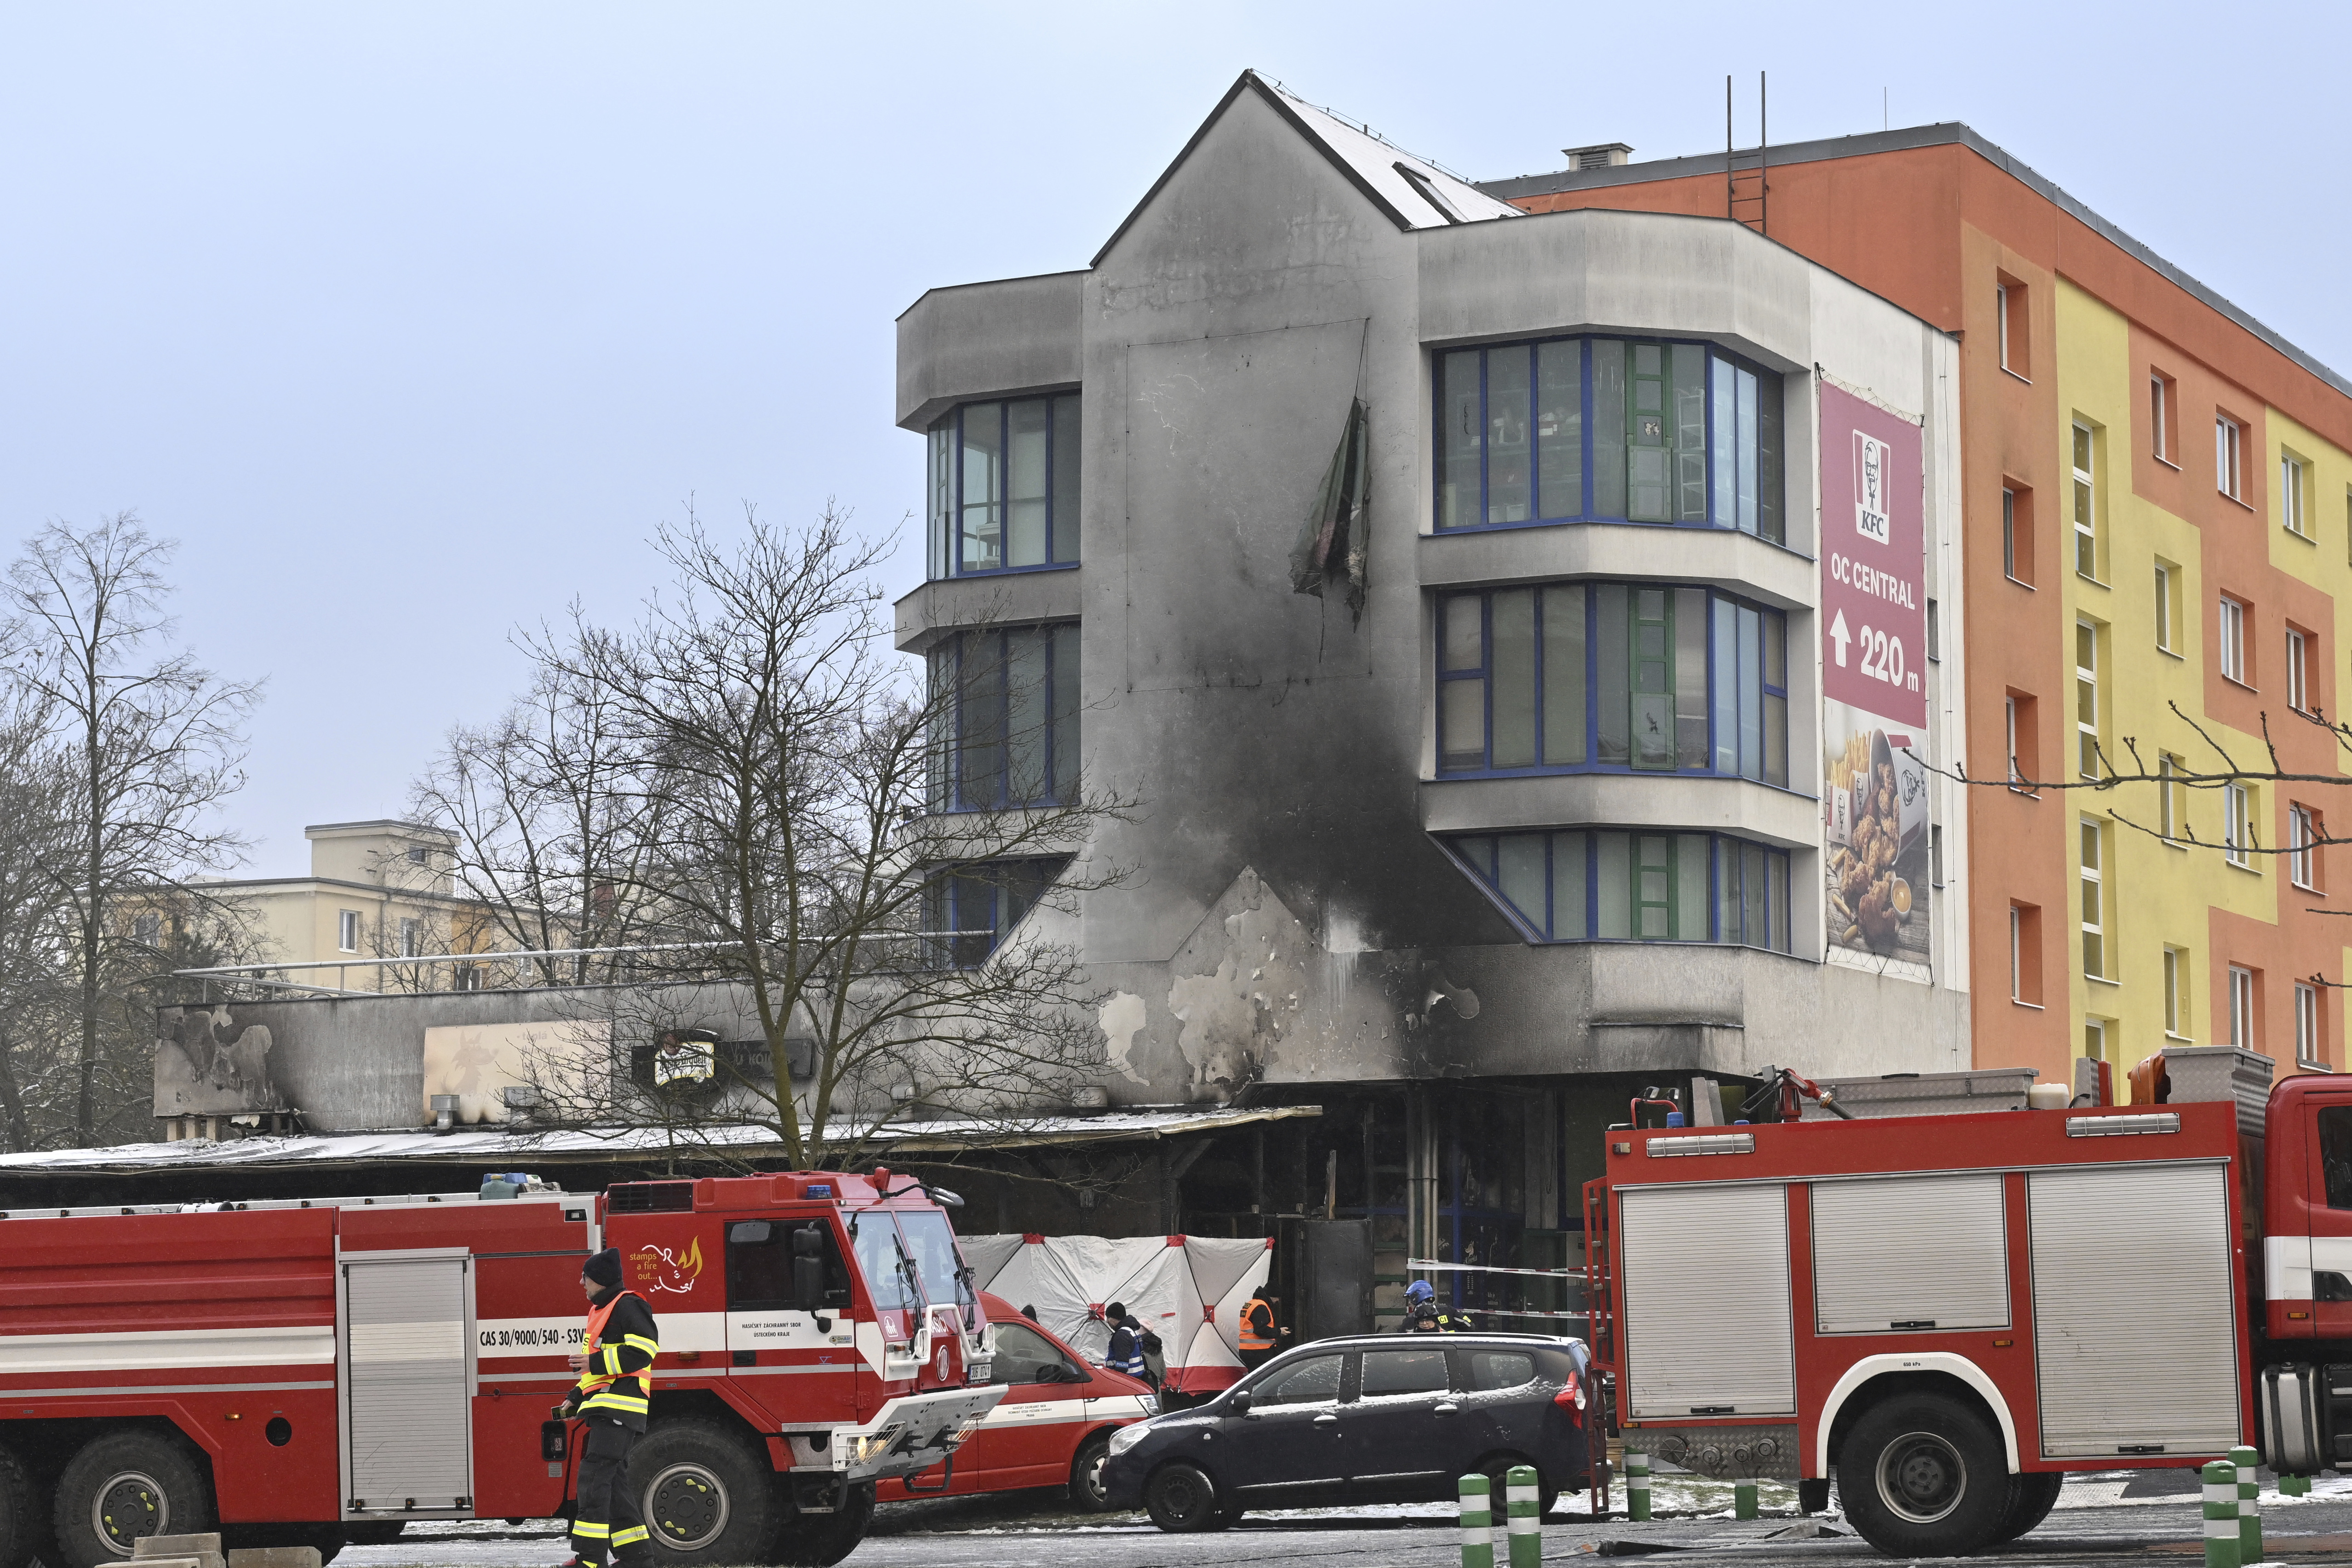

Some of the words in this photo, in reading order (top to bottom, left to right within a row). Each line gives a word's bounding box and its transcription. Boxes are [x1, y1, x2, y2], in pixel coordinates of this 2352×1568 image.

[1861, 509, 1884, 537] KFC
[1831, 552, 1850, 585] OC
[1853, 561, 1915, 611] CENTRAL
[1860, 624, 1904, 687] 220
[1907, 671, 1919, 692] m
[629, 1253, 657, 1262] stamps
[644, 1261, 657, 1270] fire
[480, 1331, 496, 1346] CAS
[498, 1328, 559, 1348] 30/9000/540
[567, 1328, 587, 1344] S3V
